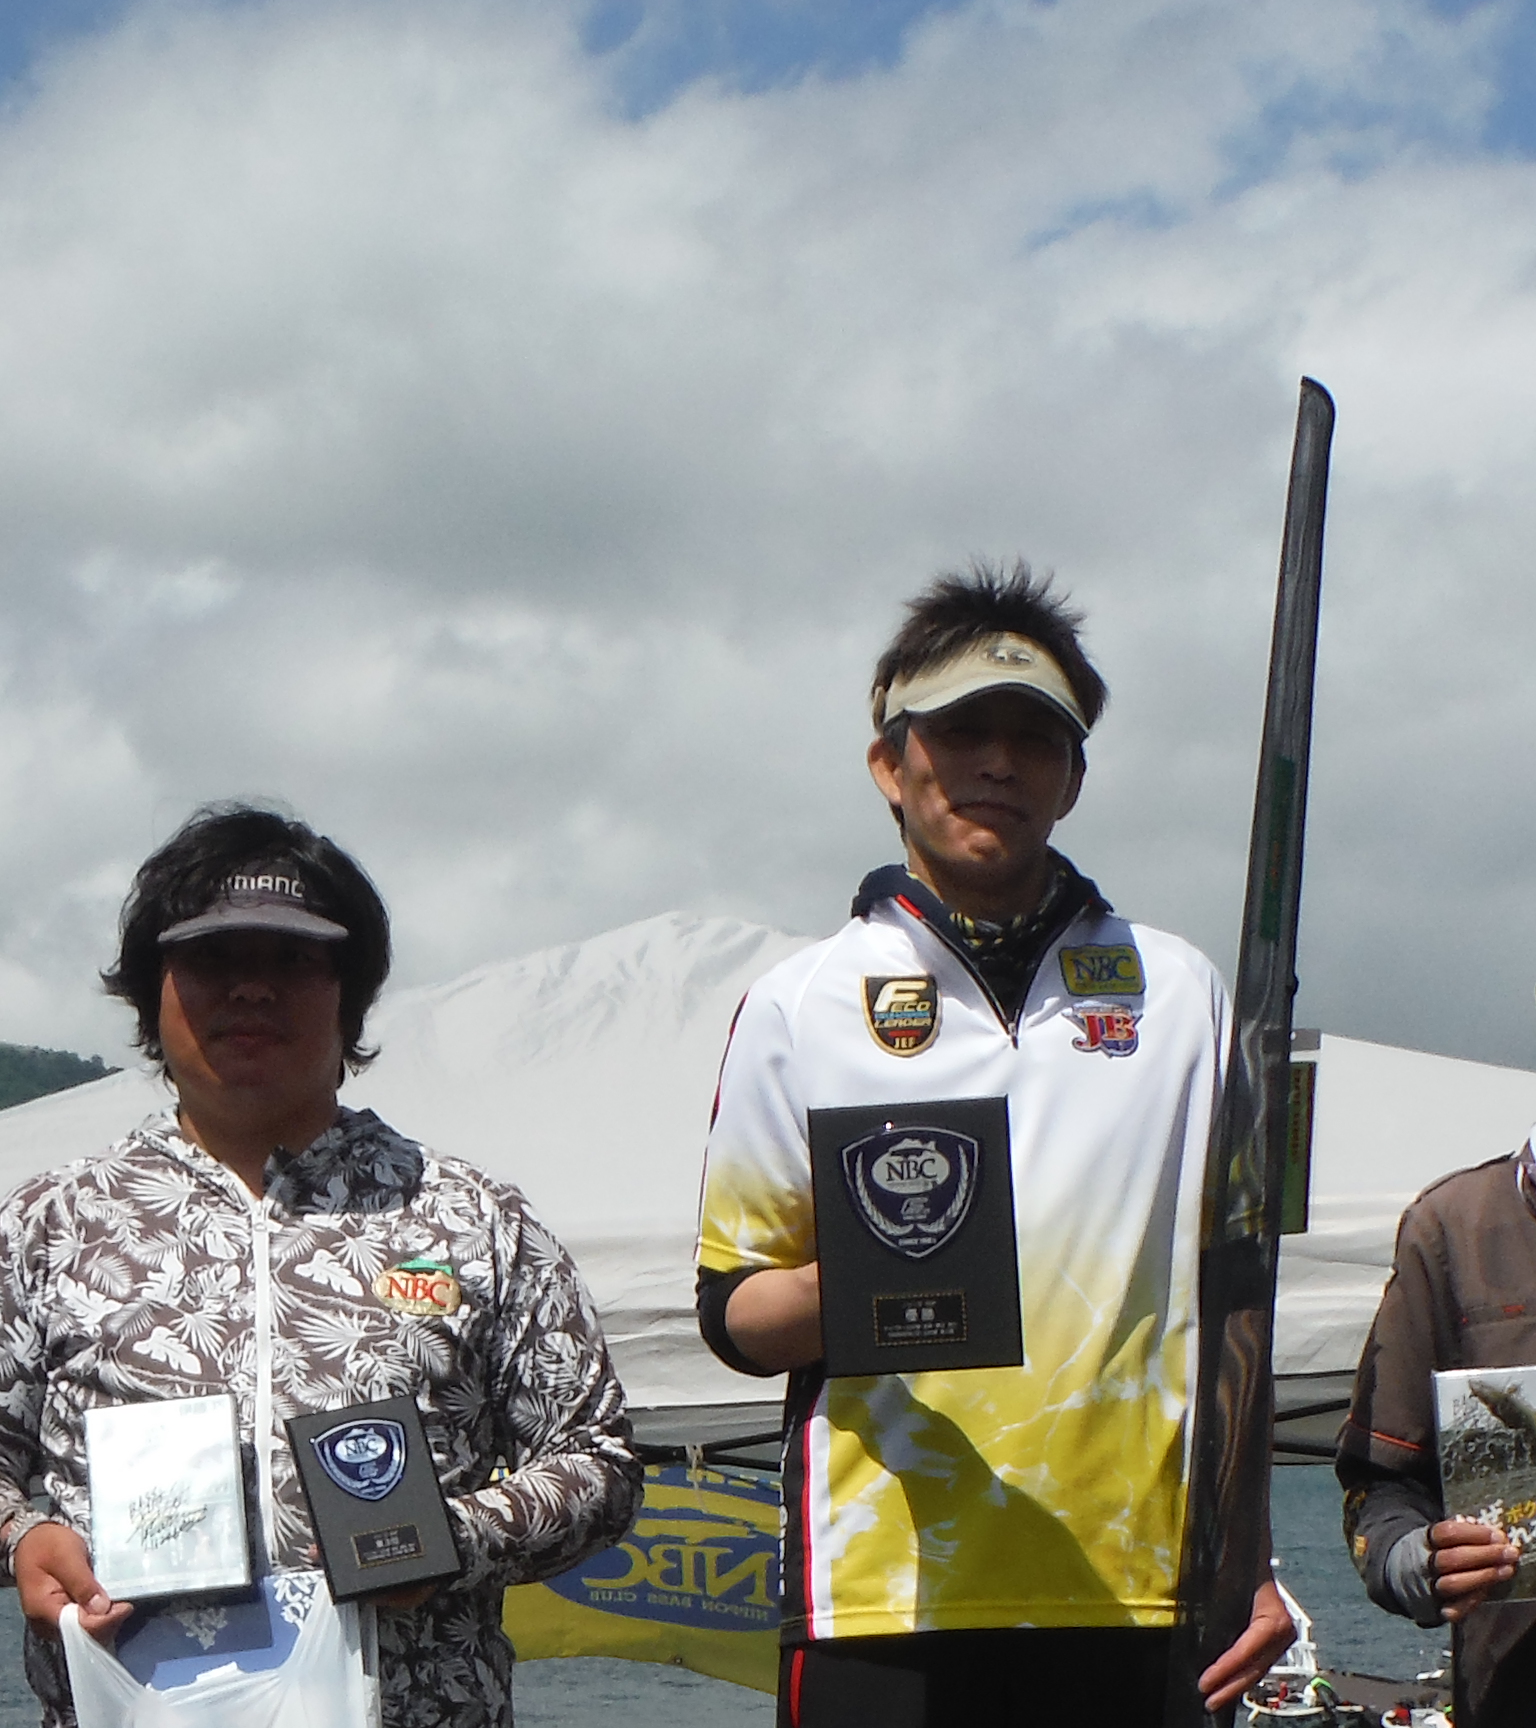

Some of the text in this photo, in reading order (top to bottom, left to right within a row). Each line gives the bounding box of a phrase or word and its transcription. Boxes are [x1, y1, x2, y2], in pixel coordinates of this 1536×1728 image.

[1071, 955, 1136, 982] NBC
[885, 1157, 938, 1181] NBC
[386, 1276, 451, 1307] NBC
